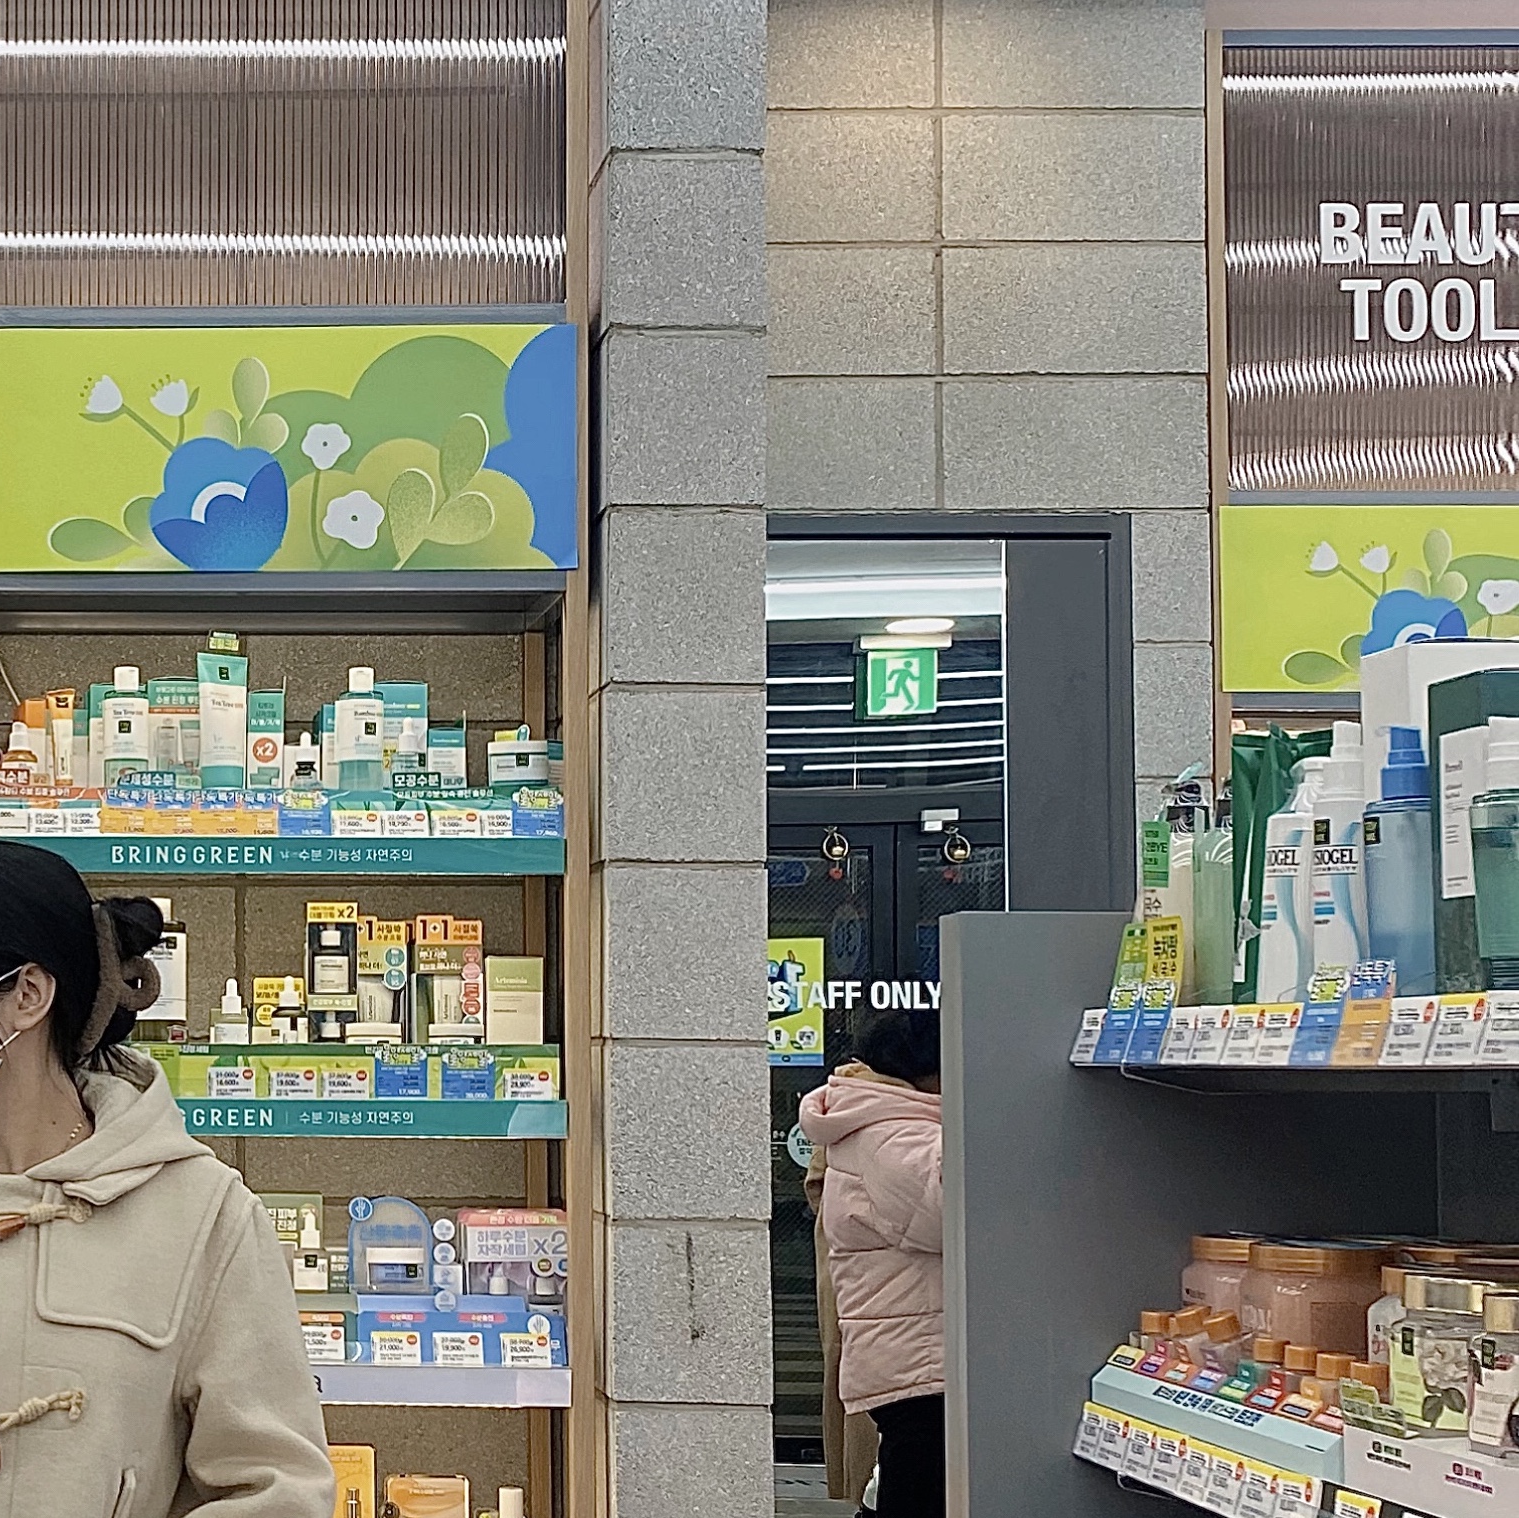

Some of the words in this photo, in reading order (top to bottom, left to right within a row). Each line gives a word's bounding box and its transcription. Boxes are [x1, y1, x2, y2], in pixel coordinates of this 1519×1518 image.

[255, 743, 274, 756] x2
[394, 774, 440, 787] 모공수분
[299, 850, 323, 862] 수분
[326, 849, 361, 862] 기능성
[365, 849, 413, 862] 자연주의
[337, 906, 355, 919] x2
[419, 919, 449, 940] 1+1
[771, 981, 862, 1010] STAFF
[870, 981, 941, 1010] ONLY
[192, 1108, 274, 1127] GREEN
[299, 1112, 323, 1124] 수분
[326, 1111, 362, 1124] 기능성
[367, 1111, 414, 1124] 자연주의
[533, 1231, 567, 1255] x2
